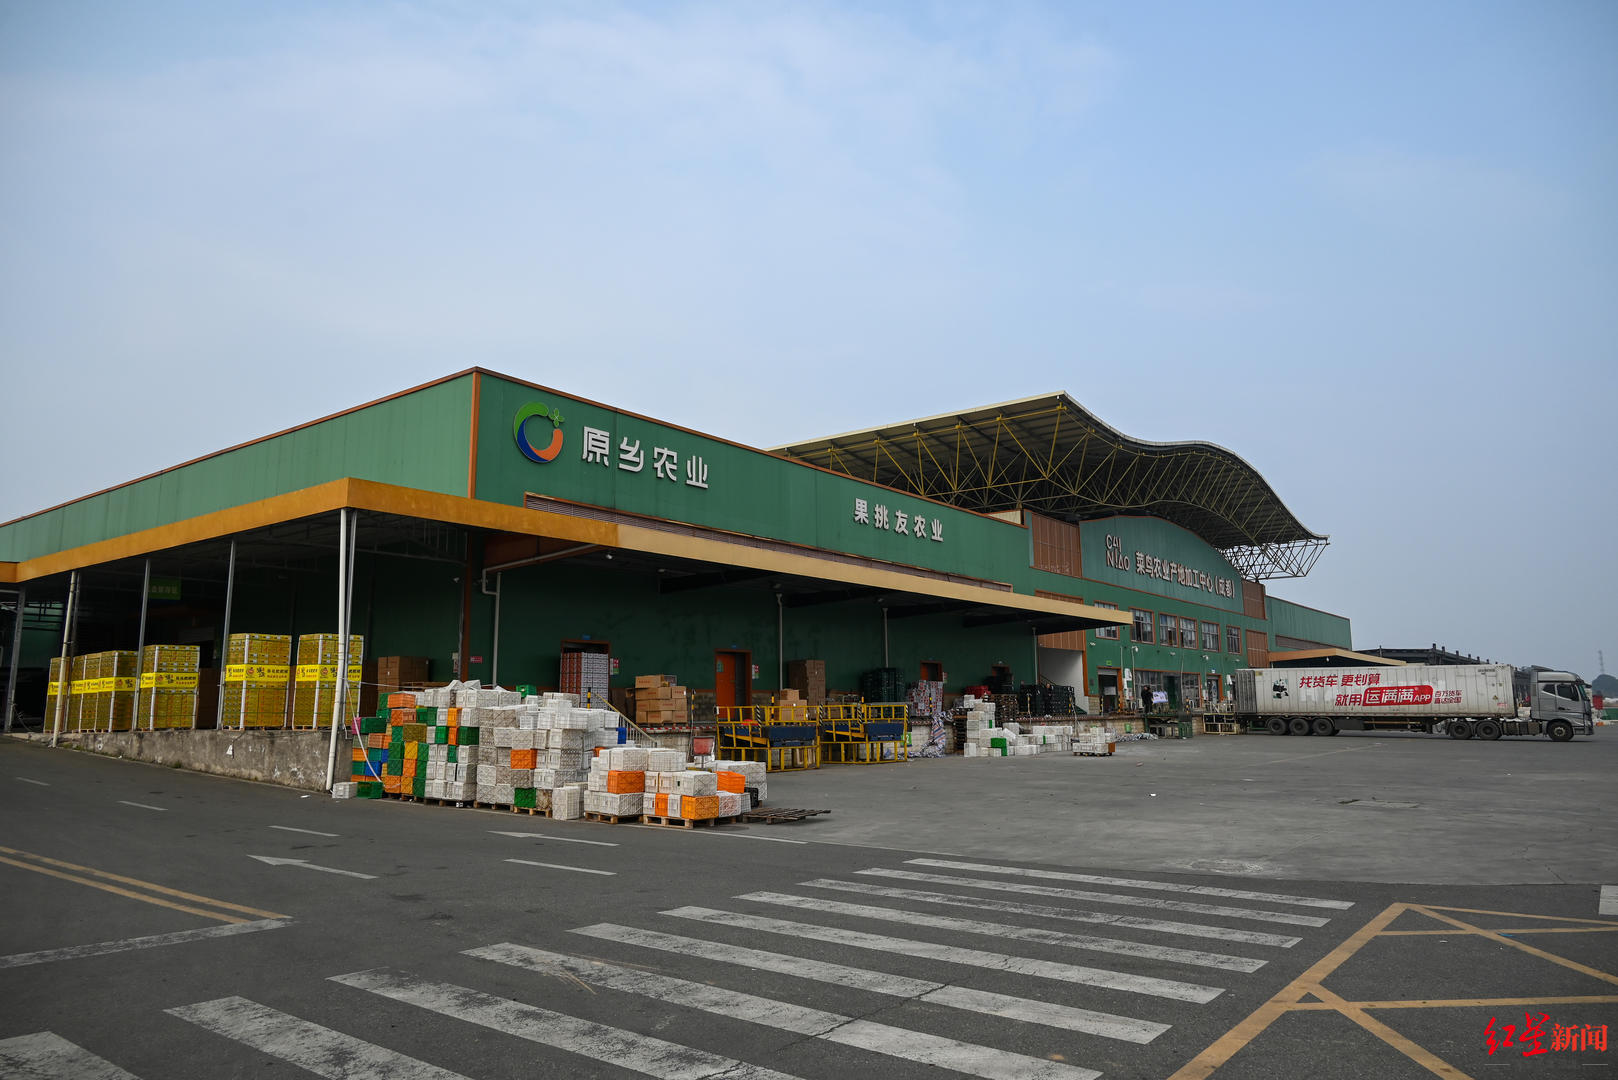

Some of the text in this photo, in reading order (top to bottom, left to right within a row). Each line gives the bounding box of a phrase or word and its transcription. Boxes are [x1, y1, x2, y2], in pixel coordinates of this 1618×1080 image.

[582, 426, 709, 489] 原乡农业
[853, 498, 944, 543] 果挑友农业
[1299, 673, 1381, 688] 找货车 更划算
[1335, 693, 1362, 706] 就用
